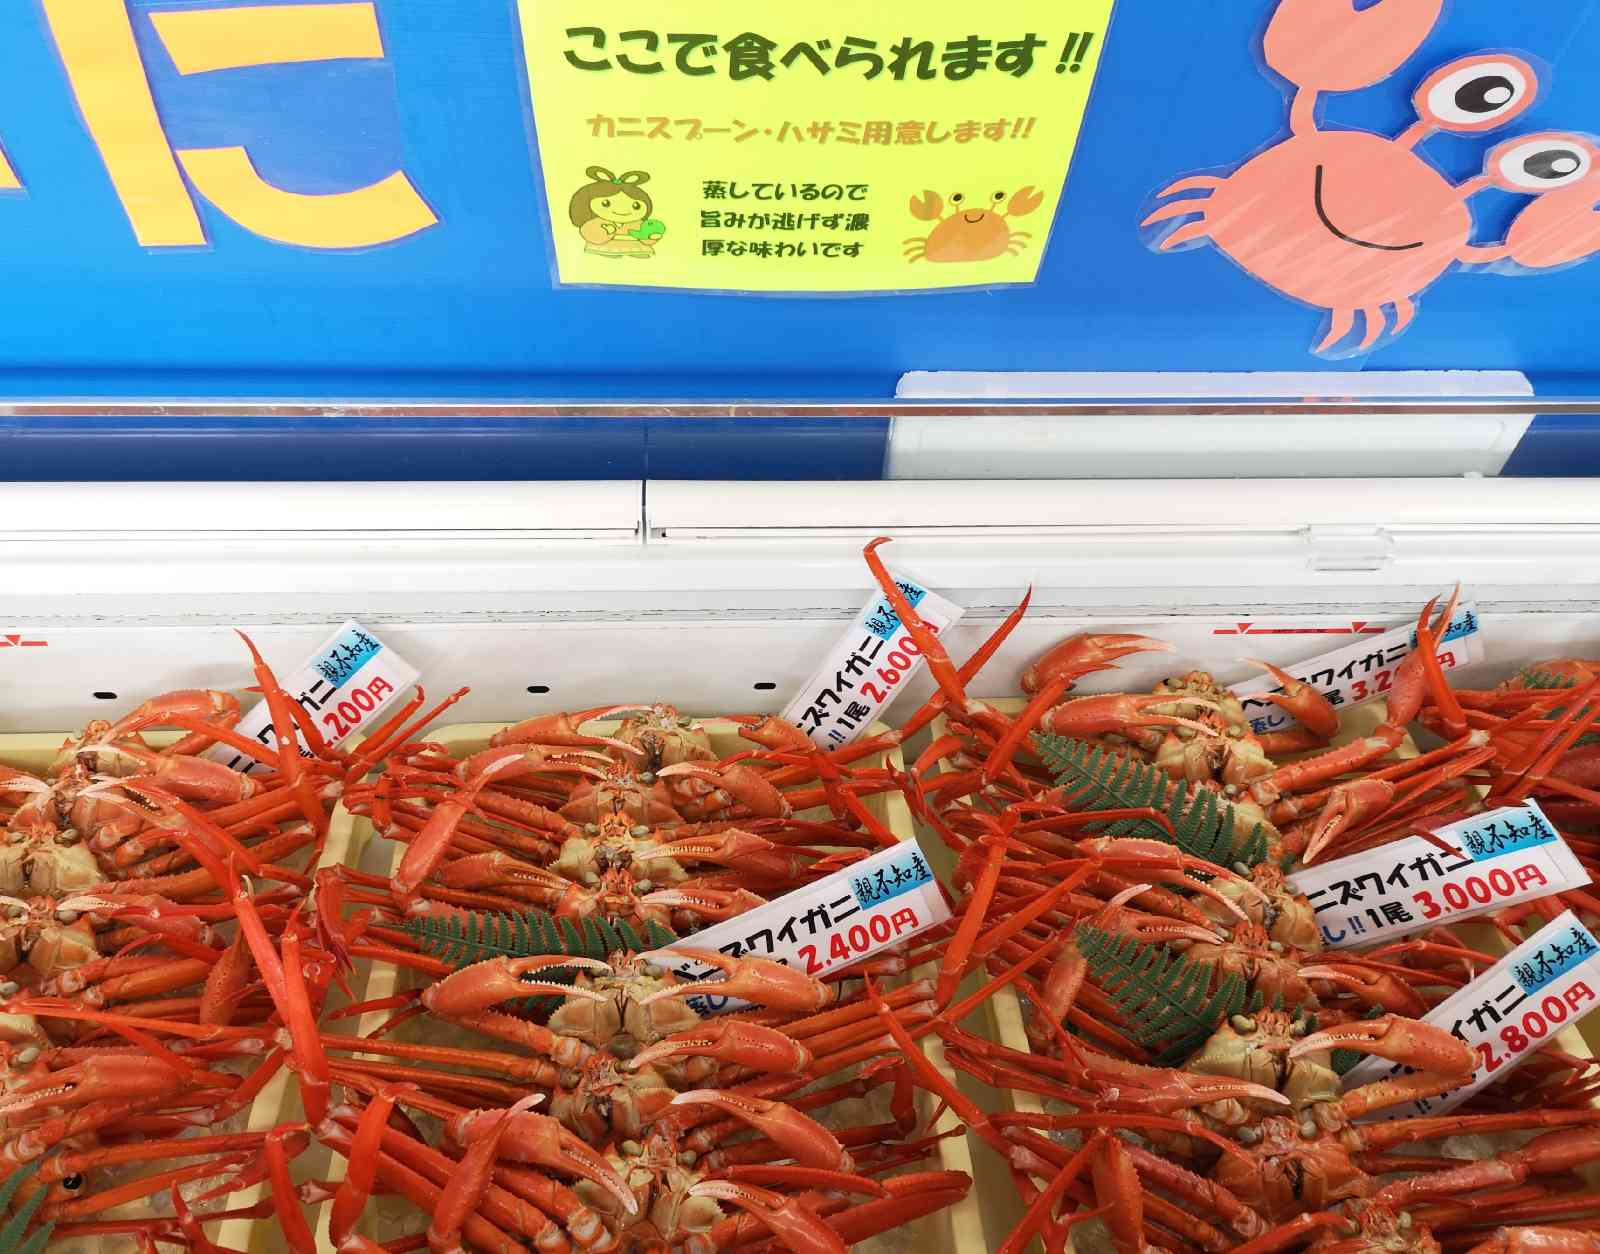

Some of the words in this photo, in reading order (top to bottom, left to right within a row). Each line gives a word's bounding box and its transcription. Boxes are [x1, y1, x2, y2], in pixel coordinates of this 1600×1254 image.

[0, 0, 439, 249] に
[702, 180, 869, 201] 蒸しているので
[700, 209, 869, 232] 旨みが逃げず濃
[702, 239, 863, 259] 厚な味わいです
[865, 581, 925, 635] 親不産
[324, 676, 394, 749] ,200円
[1464, 811, 1555, 855] 親不知産
[855, 851, 933, 905] 親不知産
[1516, 926, 1597, 988] 親不知産
